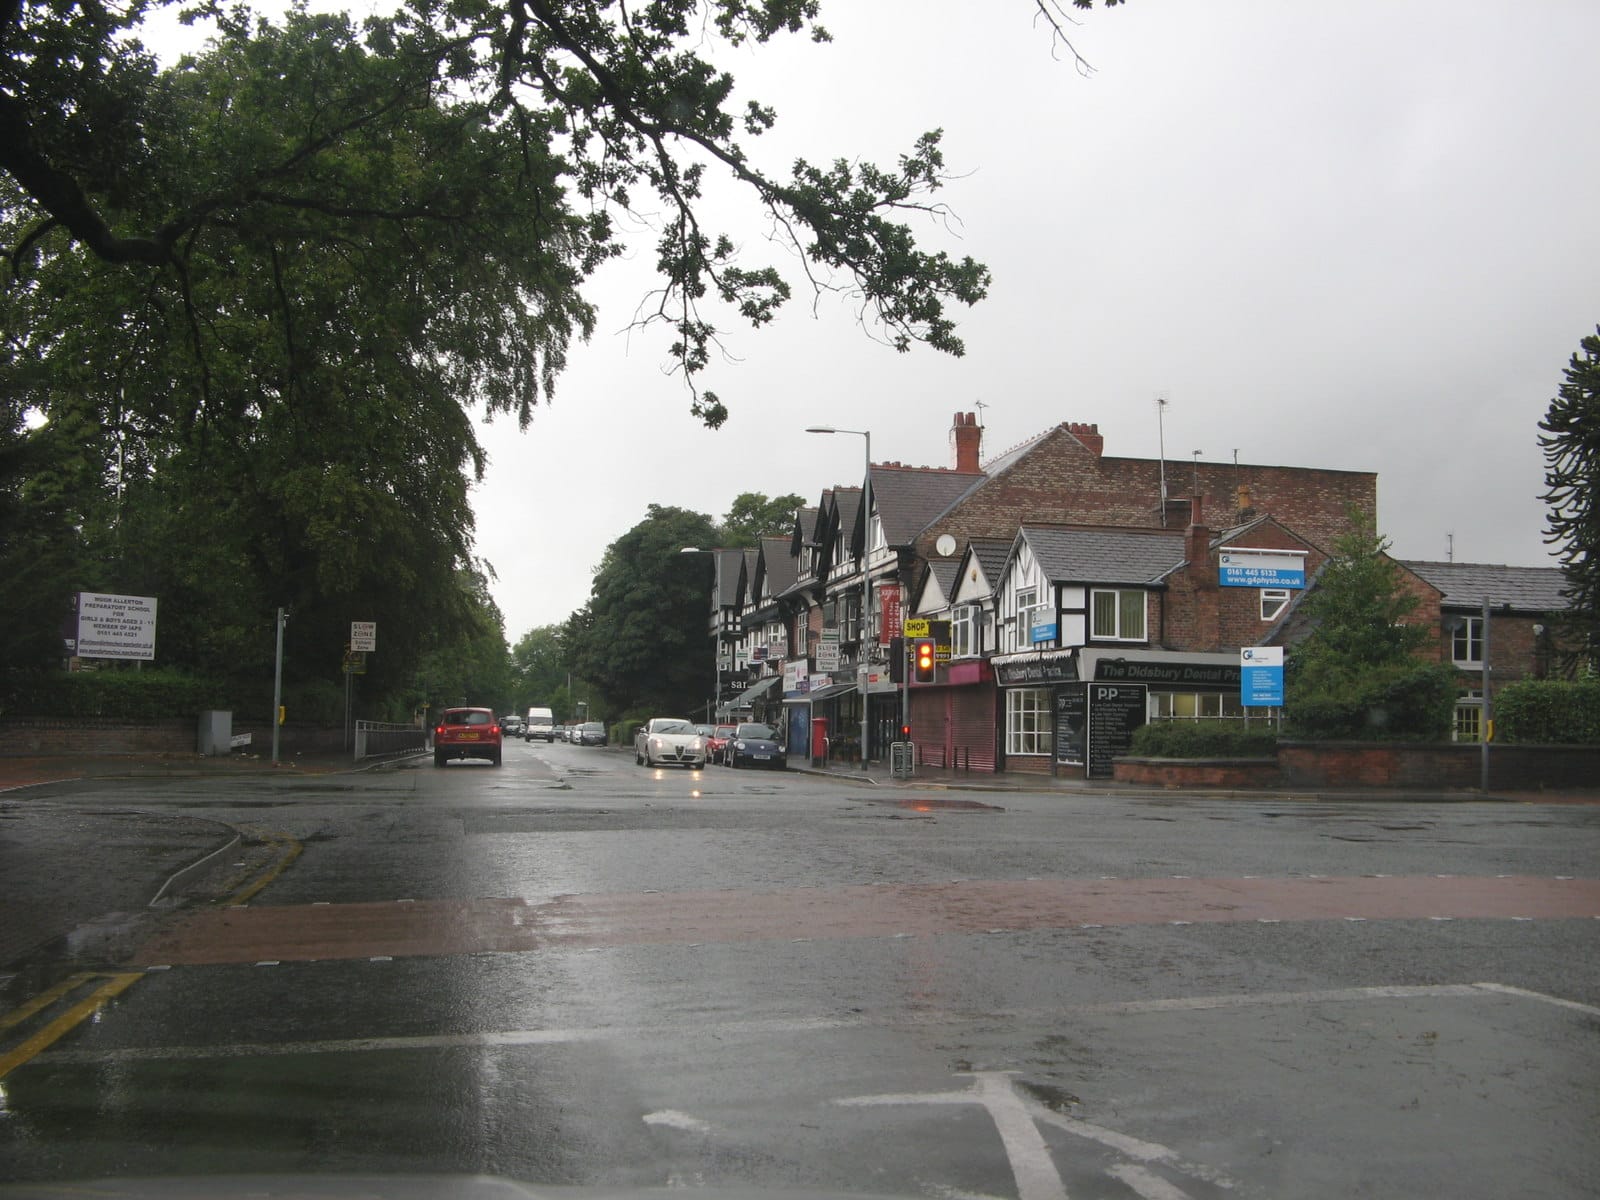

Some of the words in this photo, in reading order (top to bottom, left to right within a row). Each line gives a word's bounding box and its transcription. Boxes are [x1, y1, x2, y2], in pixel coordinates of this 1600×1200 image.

[85, 603, 126, 611] PREPARATORY
[906, 622, 926, 631] SHOP
[1103, 664, 1125, 677] The
[1127, 665, 1181, 681] Didsbury
[1183, 668, 1222, 680] Dental
